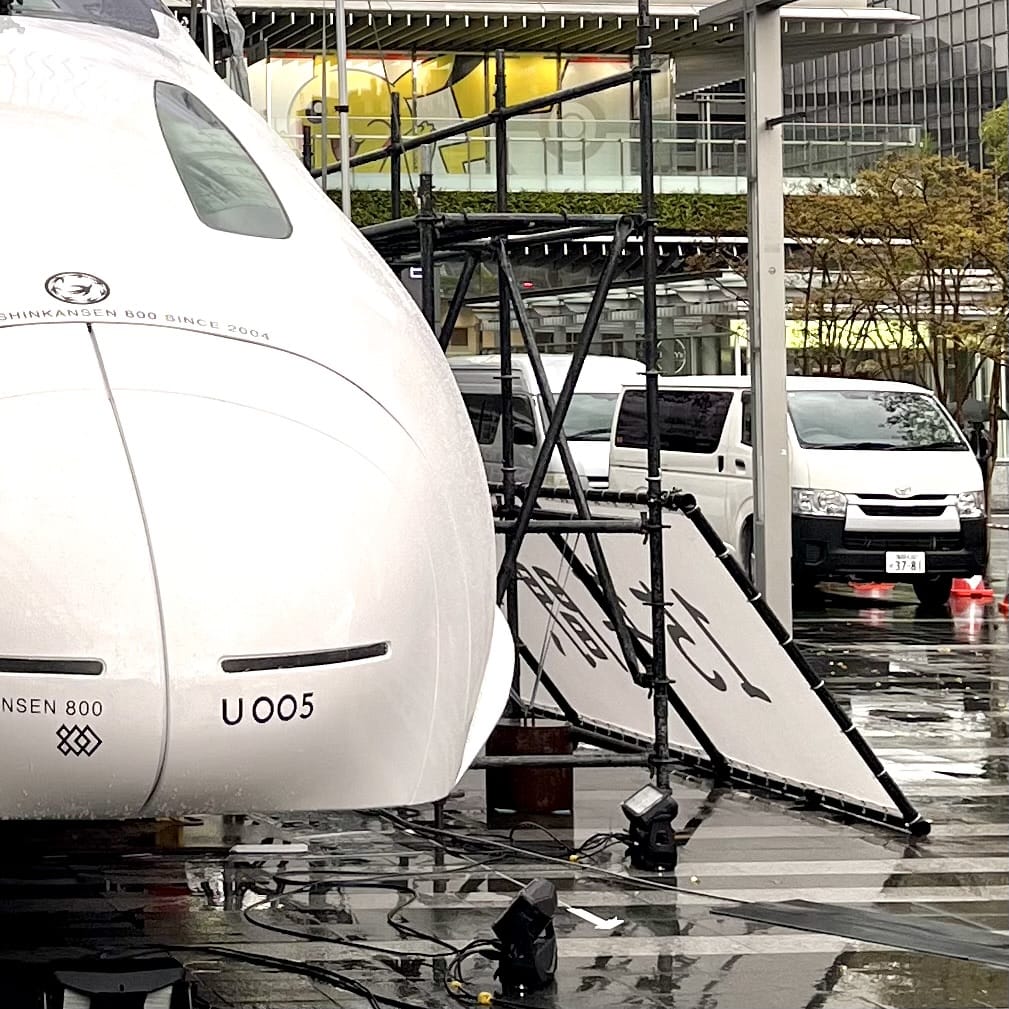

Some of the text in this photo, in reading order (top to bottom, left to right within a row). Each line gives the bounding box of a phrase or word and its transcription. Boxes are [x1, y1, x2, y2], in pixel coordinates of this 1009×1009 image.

[125, 309, 157, 320] 800
[165, 313, 220, 330] SINCE
[227, 323, 271, 341] 2004
[64, 699, 103, 718] 800
